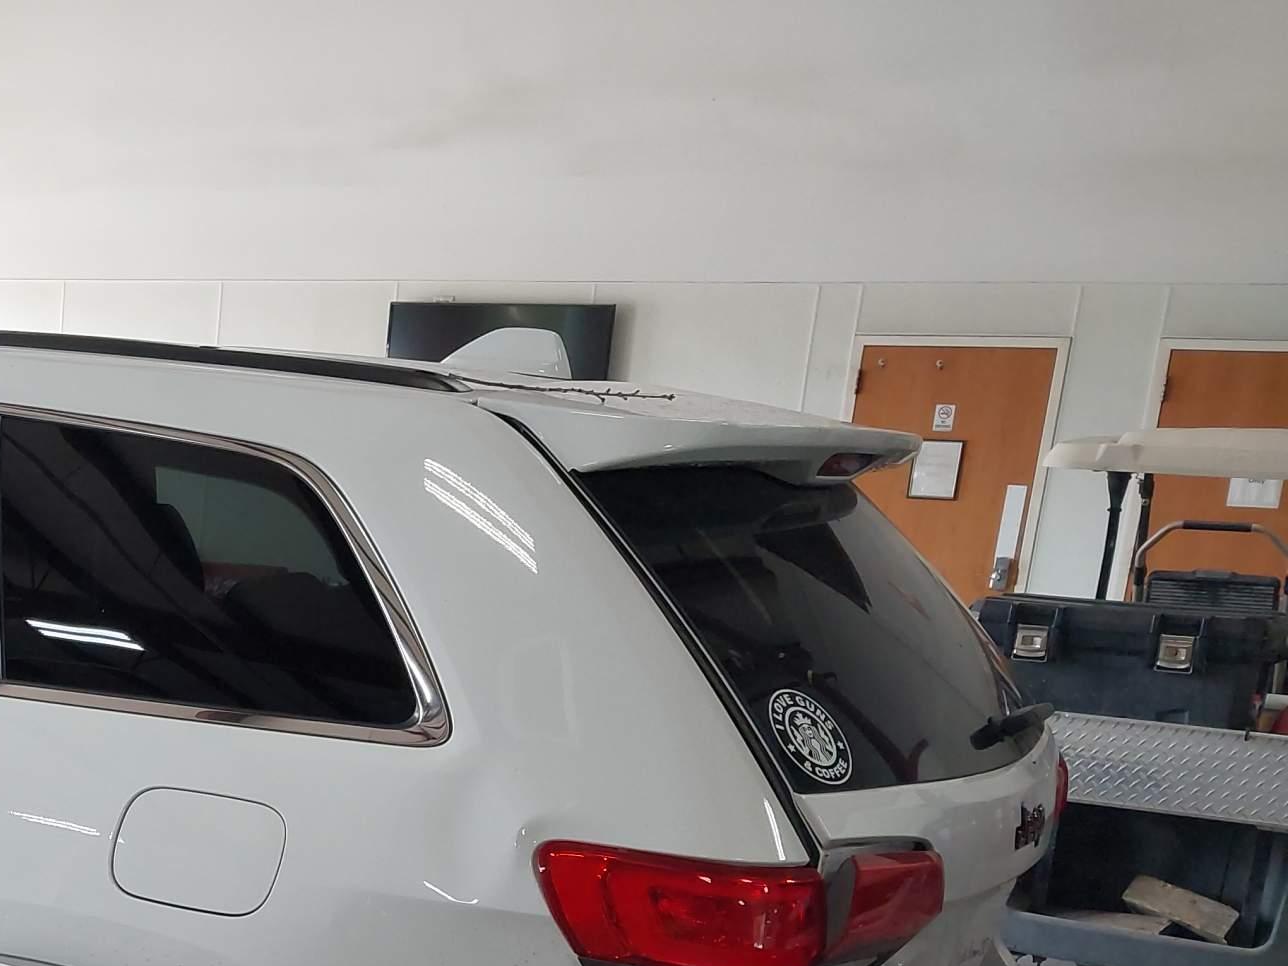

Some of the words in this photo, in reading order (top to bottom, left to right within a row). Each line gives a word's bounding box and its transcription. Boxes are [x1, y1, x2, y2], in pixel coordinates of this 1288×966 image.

[773, 694, 794, 720] LOVE
[795, 696, 834, 731] GUNS
[803, 760, 813, 772] &
[815, 758, 848, 779] COFFEE
